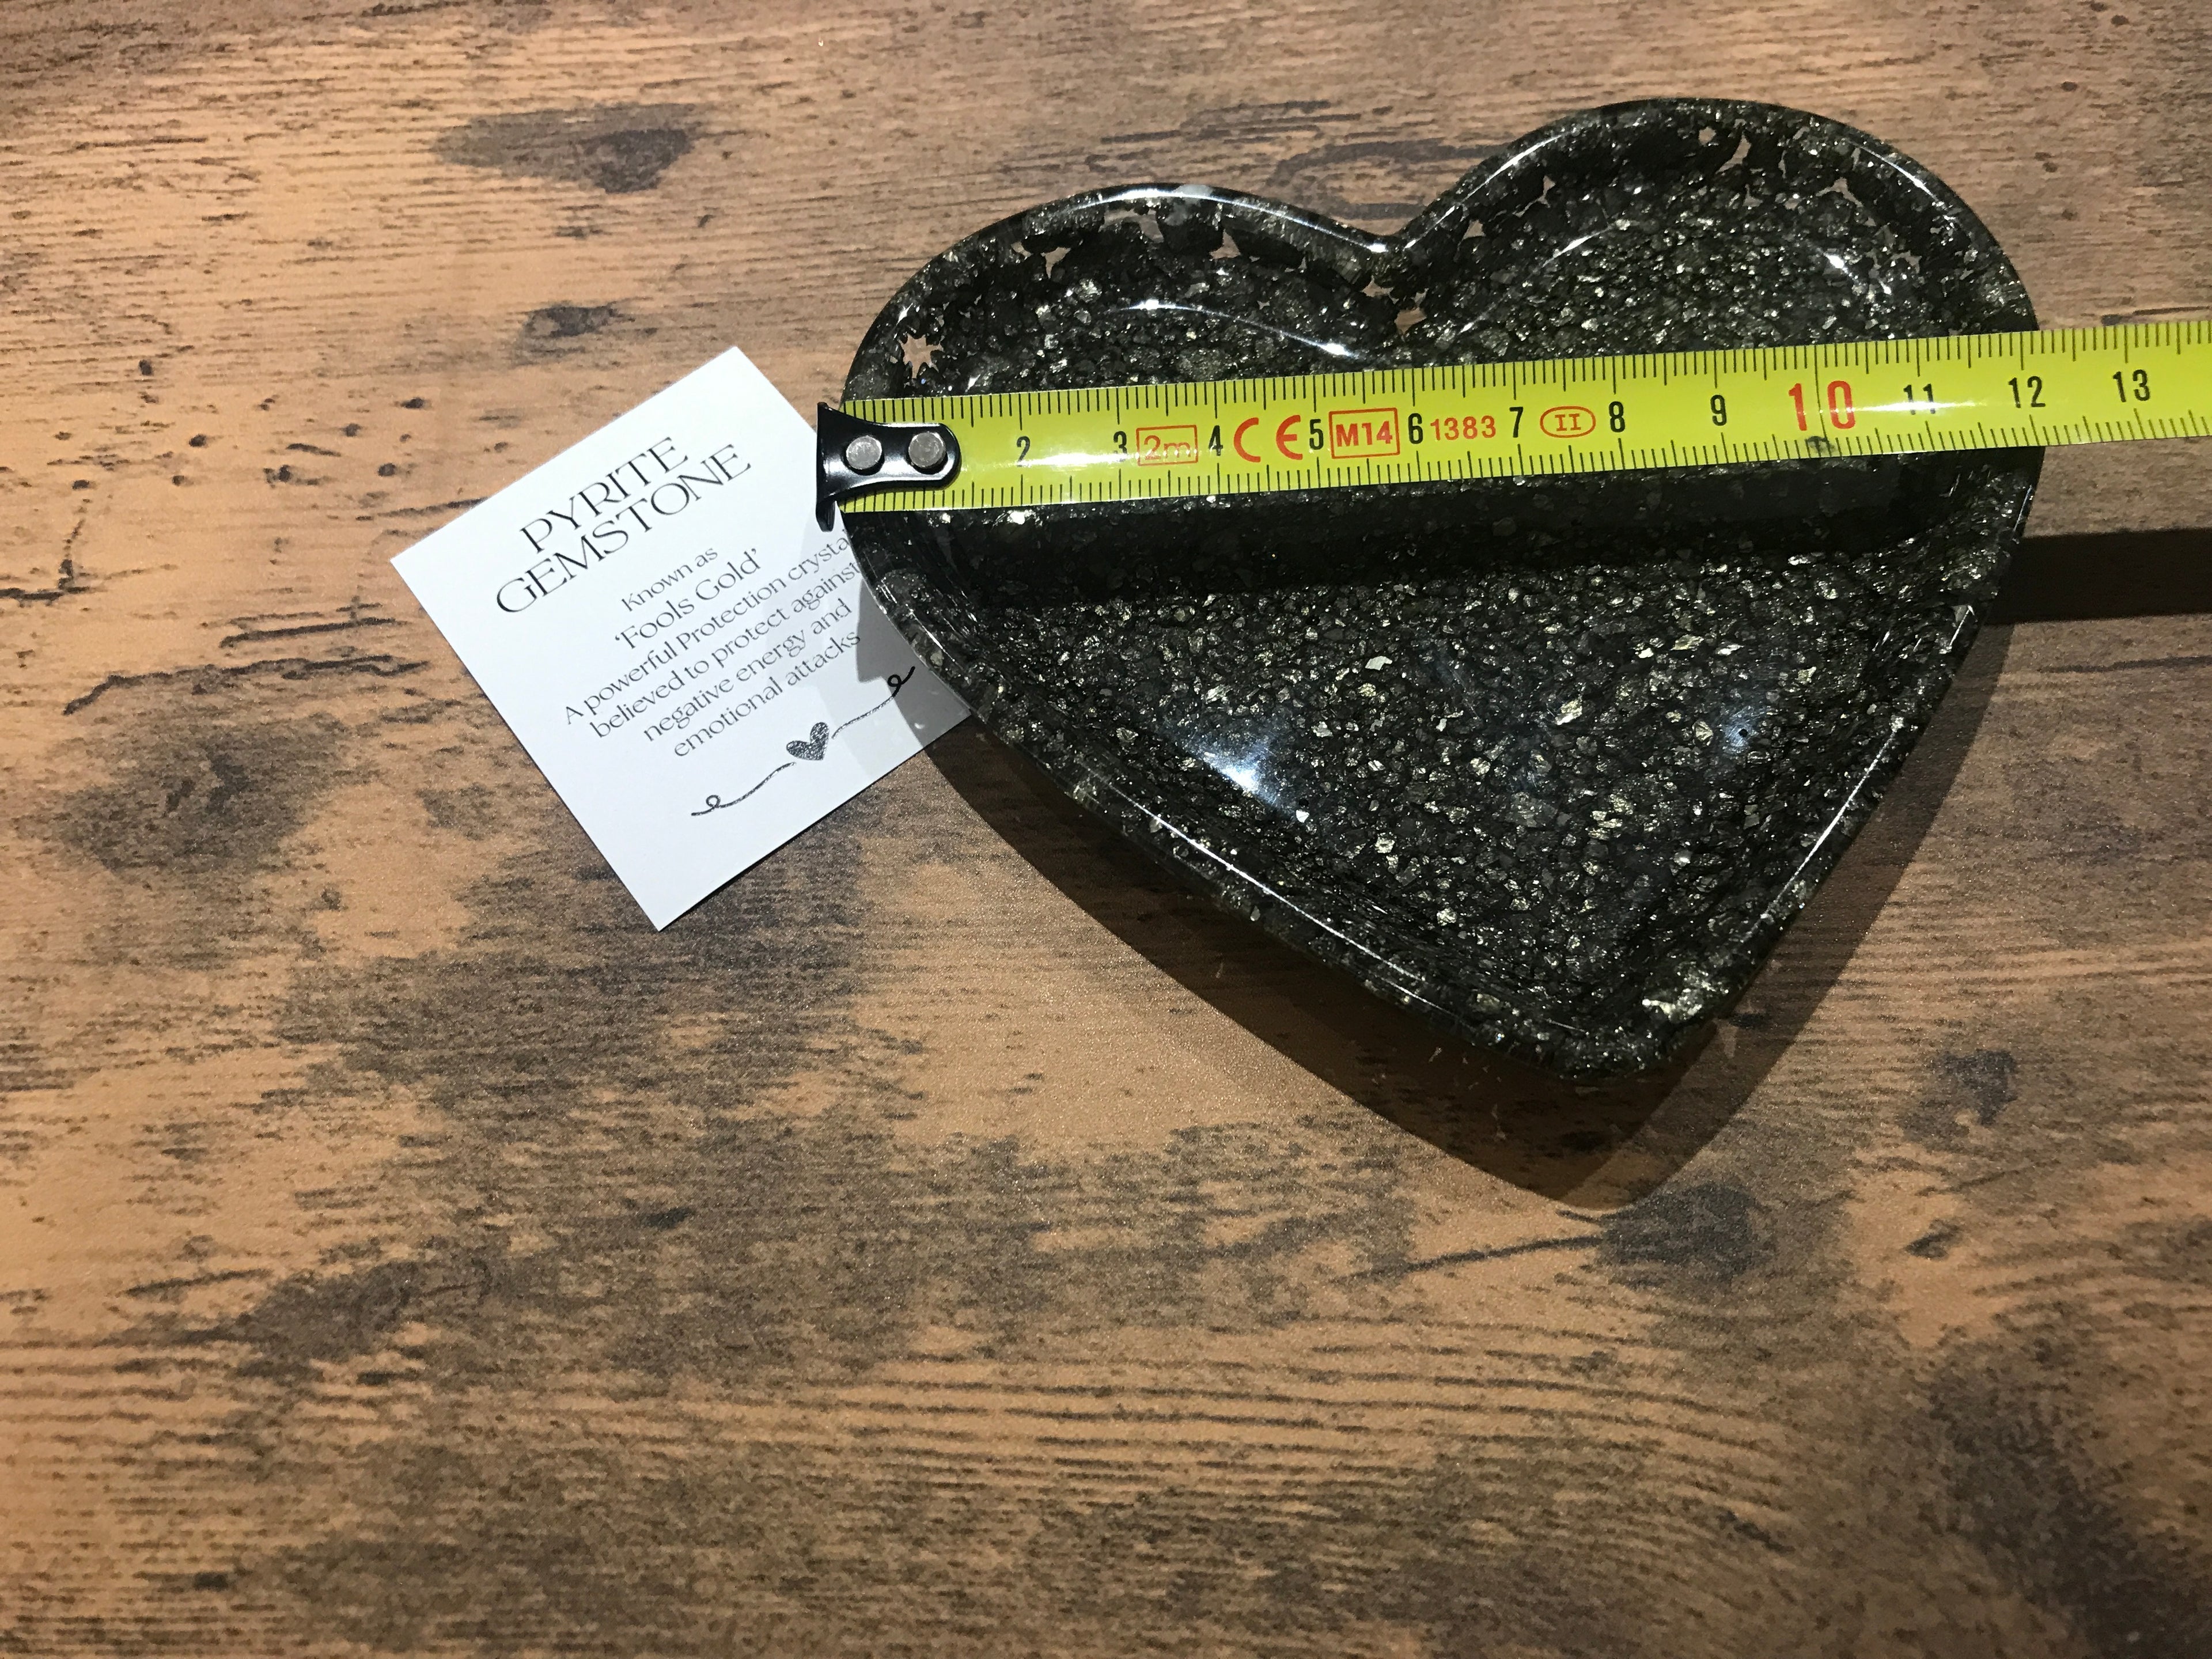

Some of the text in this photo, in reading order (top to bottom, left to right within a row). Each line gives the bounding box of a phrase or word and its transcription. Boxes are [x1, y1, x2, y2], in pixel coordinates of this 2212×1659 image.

[1016, 369, 2151, 467] 2 3 2m 4 CE 5 M14 6 1383 7 II 8 9 10 11 12 13
[497, 444, 751, 613] GEMSTONE
[520, 437, 688, 554] PYRITE
[566, 528, 851, 725] A powerful Protection crysta
[622, 548, 718, 611] Known as
[590, 562, 861, 738] believed to protect against
[643, 598, 852, 741] negative energy and
[675, 631, 861, 756] emotional attacks
